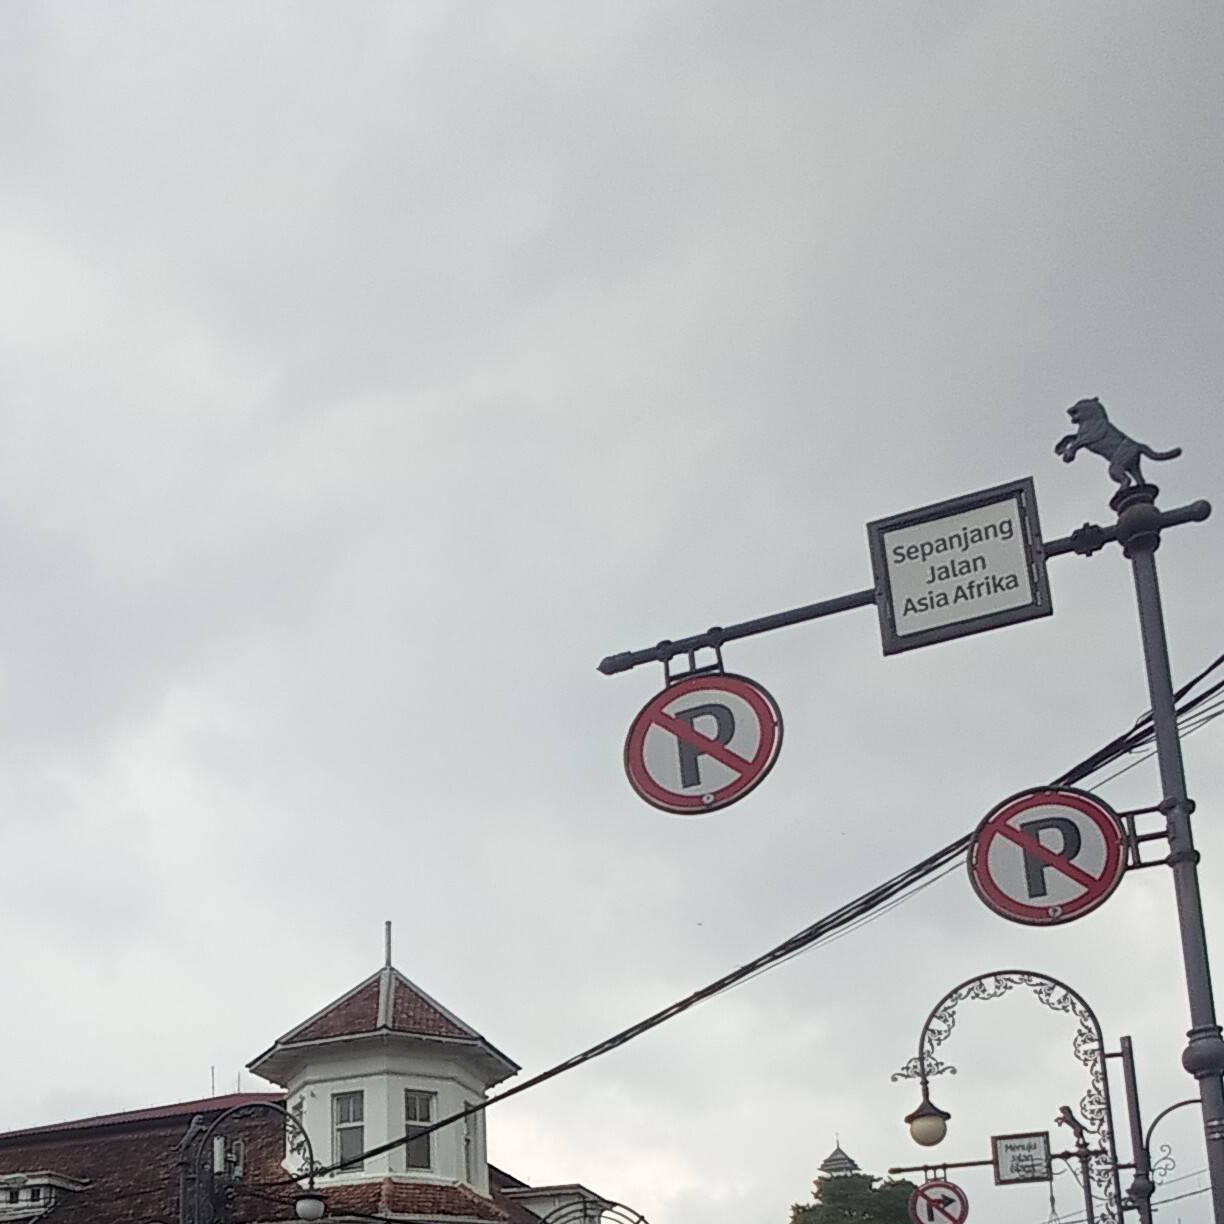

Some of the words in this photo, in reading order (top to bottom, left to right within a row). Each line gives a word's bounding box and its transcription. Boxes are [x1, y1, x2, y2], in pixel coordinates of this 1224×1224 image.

[892, 518, 1014, 564] Sepanjang
[926, 555, 987, 584] Jalan
[902, 590, 949, 617] Asia
[953, 572, 1020, 604] Afrika
